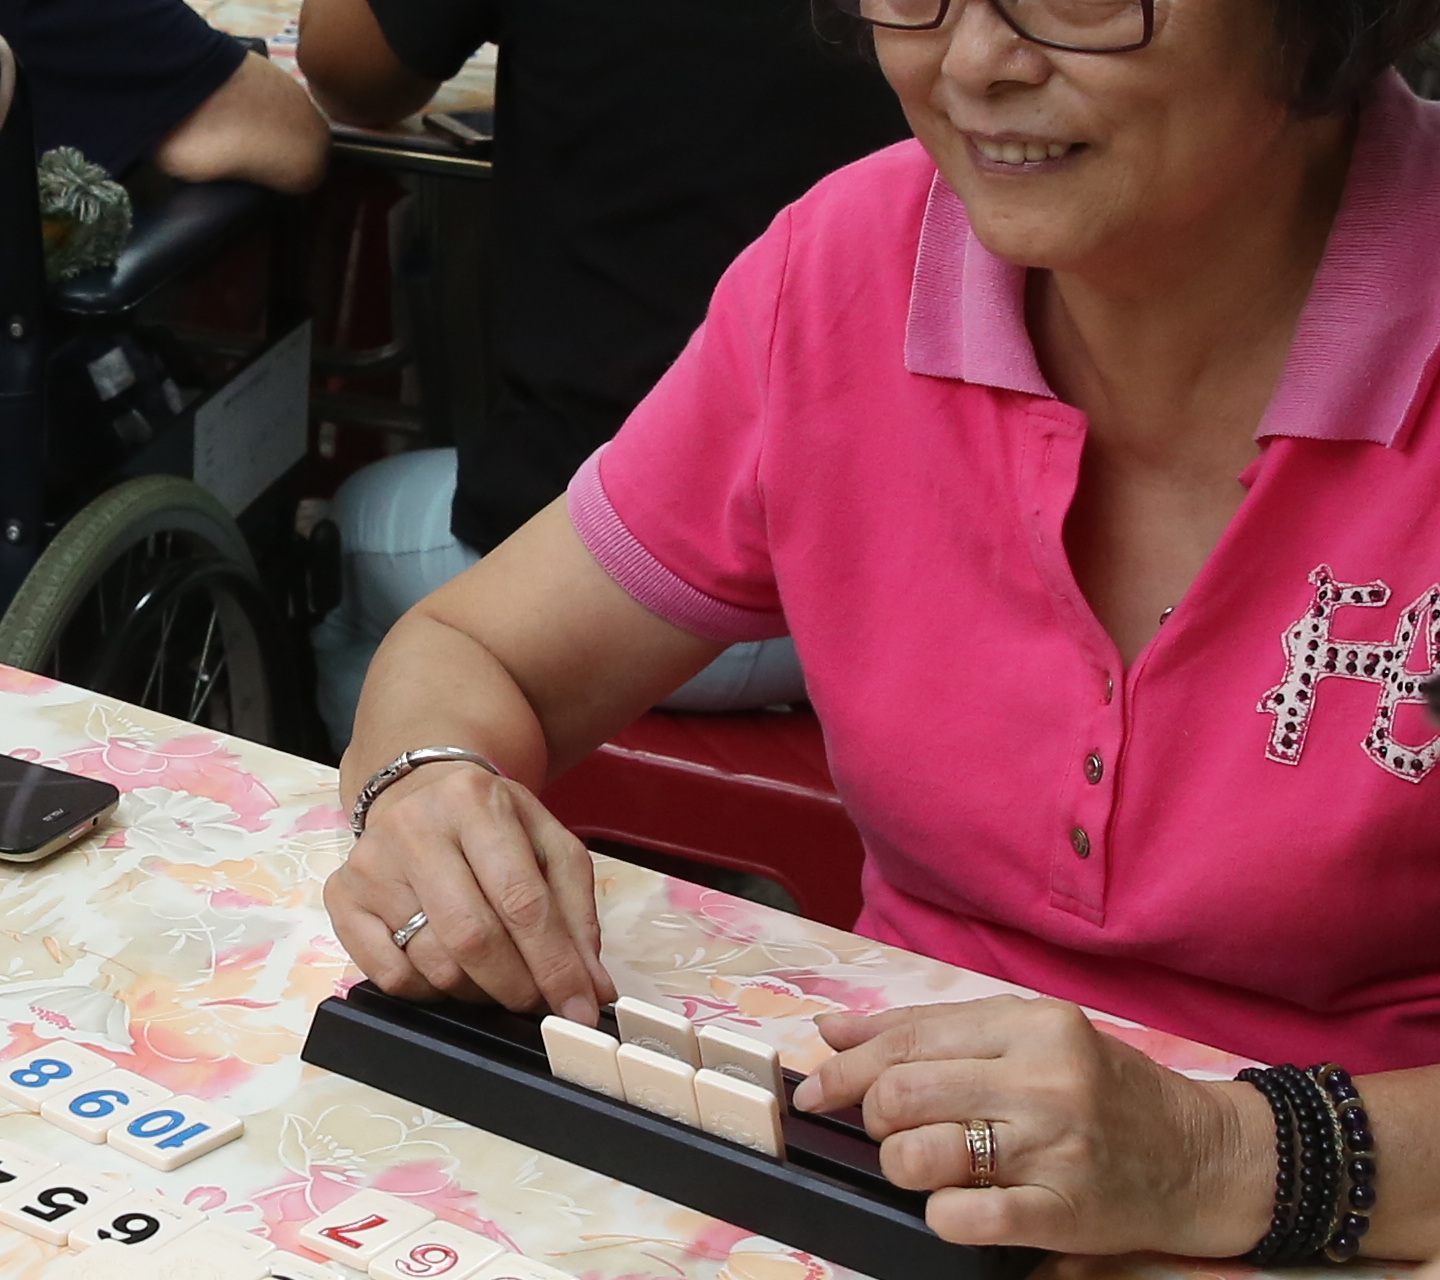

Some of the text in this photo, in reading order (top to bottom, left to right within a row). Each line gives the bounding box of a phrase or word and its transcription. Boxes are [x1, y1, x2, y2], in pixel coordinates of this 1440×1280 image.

[11, 1059, 210, 1149] 8 9 10
[21, 1188, 88, 1222] 5
[98, 1213, 159, 1244] 6
[326, 1217, 386, 1248] 7
[395, 1244, 458, 1277] 6
